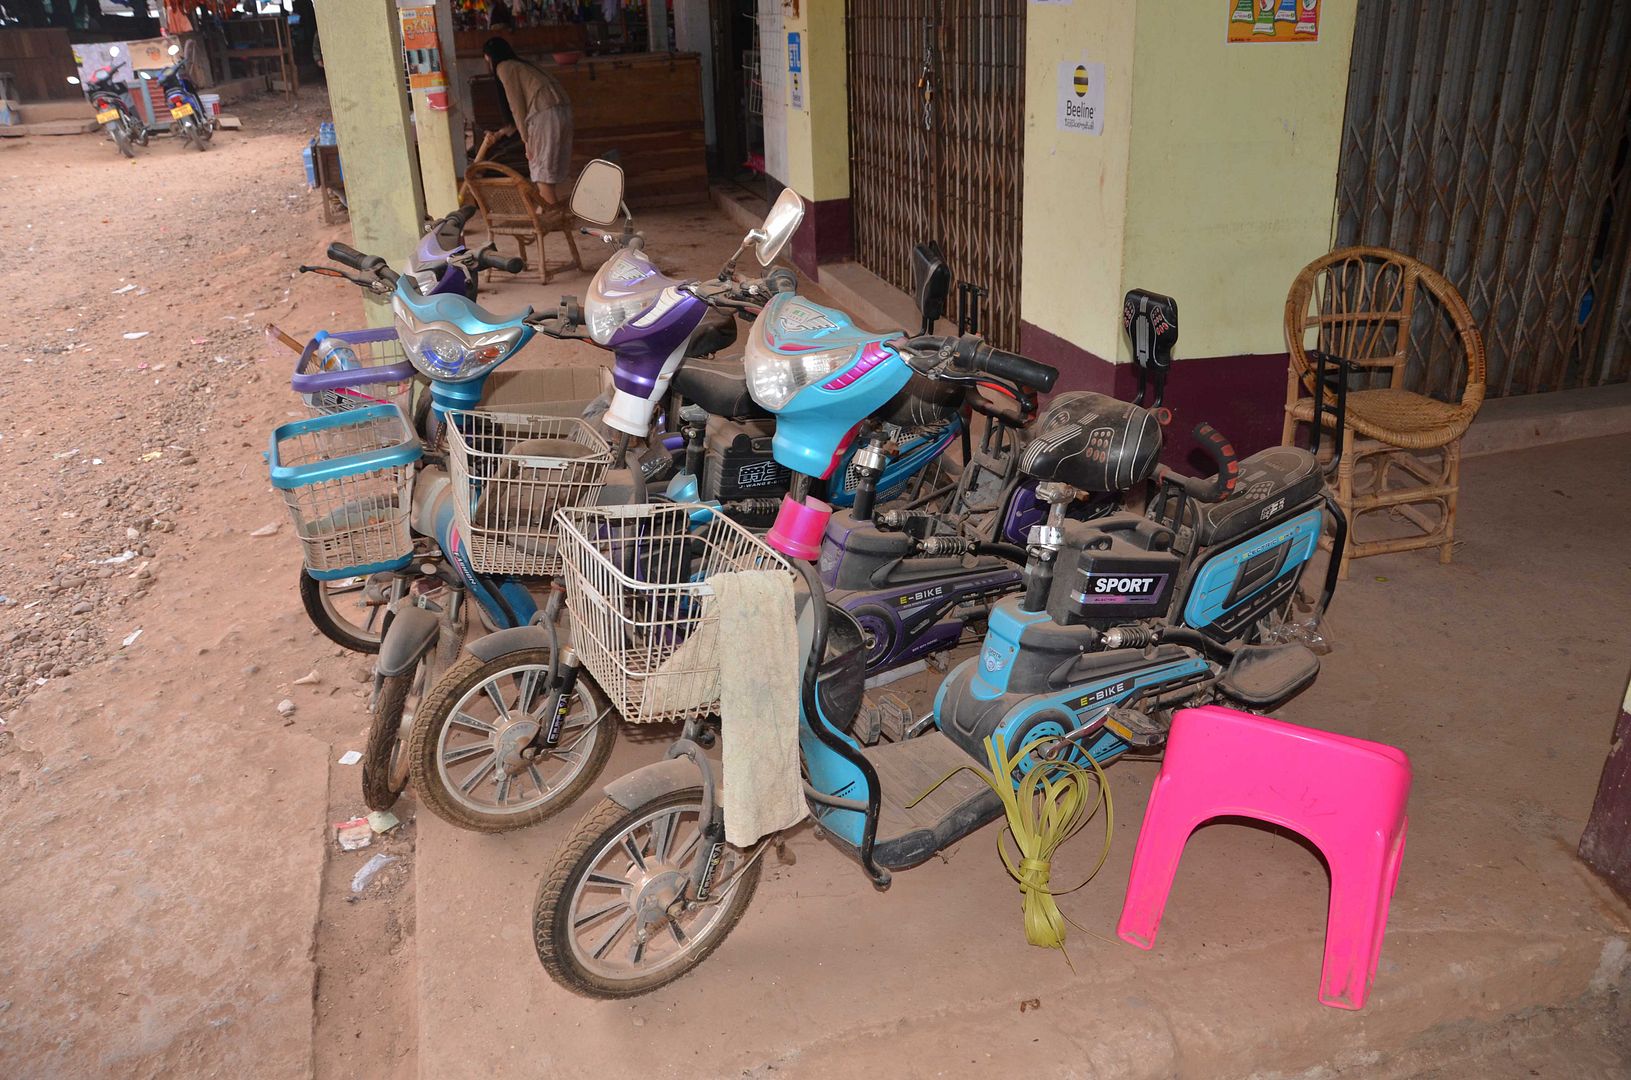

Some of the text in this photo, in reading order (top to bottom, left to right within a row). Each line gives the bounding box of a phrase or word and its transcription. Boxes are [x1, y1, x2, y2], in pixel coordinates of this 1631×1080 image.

[1066, 100, 1094, 119] Beeline
[1094, 578, 1153, 593] SPORT
[899, 586, 943, 605] E-BIKE
[1080, 682, 1124, 706] E-BIKE
